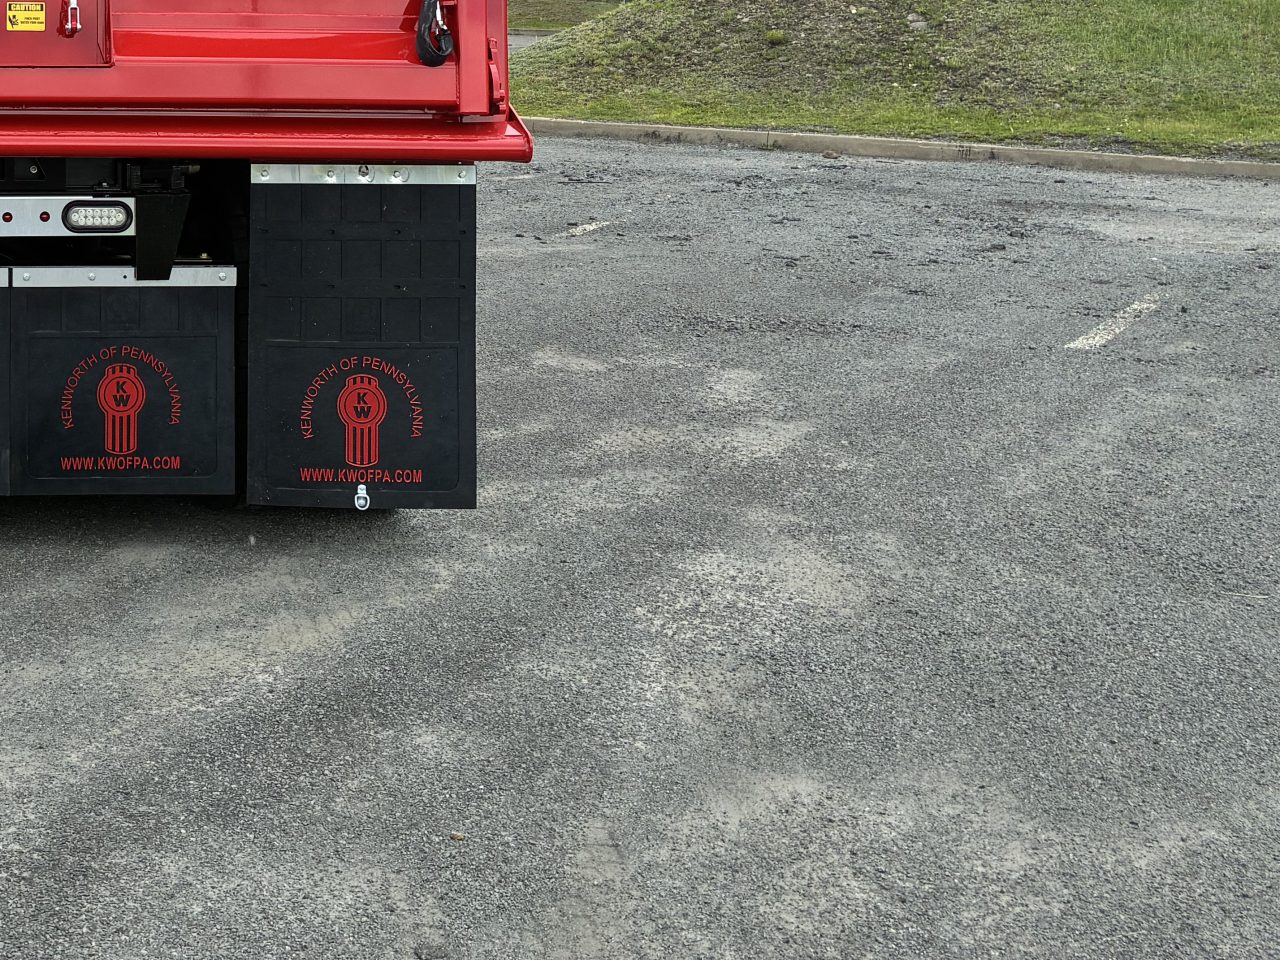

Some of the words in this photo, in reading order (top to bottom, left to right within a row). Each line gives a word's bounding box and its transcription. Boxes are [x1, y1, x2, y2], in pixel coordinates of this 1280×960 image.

[10, 3, 42, 11] CAUTION
[61, 354, 98, 429] KENWORTH
[99, 345, 117, 360] OF
[121, 345, 182, 425] PENNSYLVANIA
[300, 363, 339, 439] KENWORTH
[340, 356, 358, 370] OF
[362, 356, 424, 438] PENNSYLVANIA
[60, 455, 181, 470] WWW.KWOFPA.COM
[300, 467, 422, 483] WWW.KWOFPA.COM
